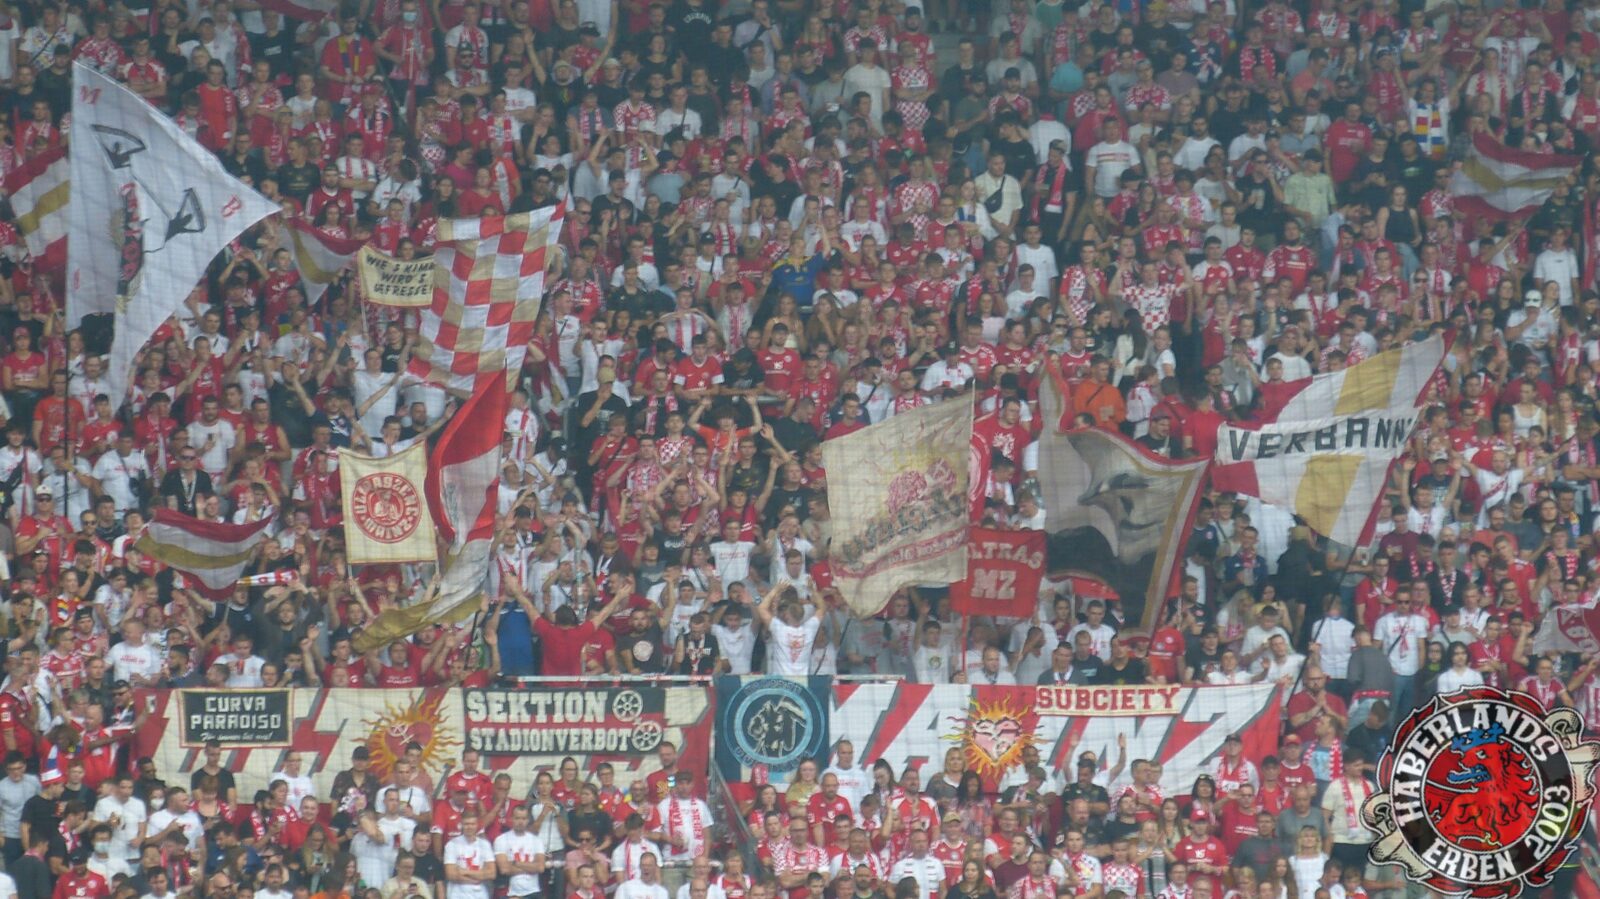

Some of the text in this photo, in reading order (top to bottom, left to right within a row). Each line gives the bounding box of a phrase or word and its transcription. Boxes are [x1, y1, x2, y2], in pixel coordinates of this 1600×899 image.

[381, 272, 414, 285] WIRD
[1229, 418, 1412, 461] VERBANN
[967, 542, 1045, 569] LTRAS
[971, 568, 1017, 600] MZ
[205, 696, 266, 712] CURVA
[466, 690, 608, 723] SEKTION
[1038, 686, 1181, 711] SUBCIETY
[190, 714, 281, 730] PARADISO
[470, 728, 632, 751] STADIONVERBOT
